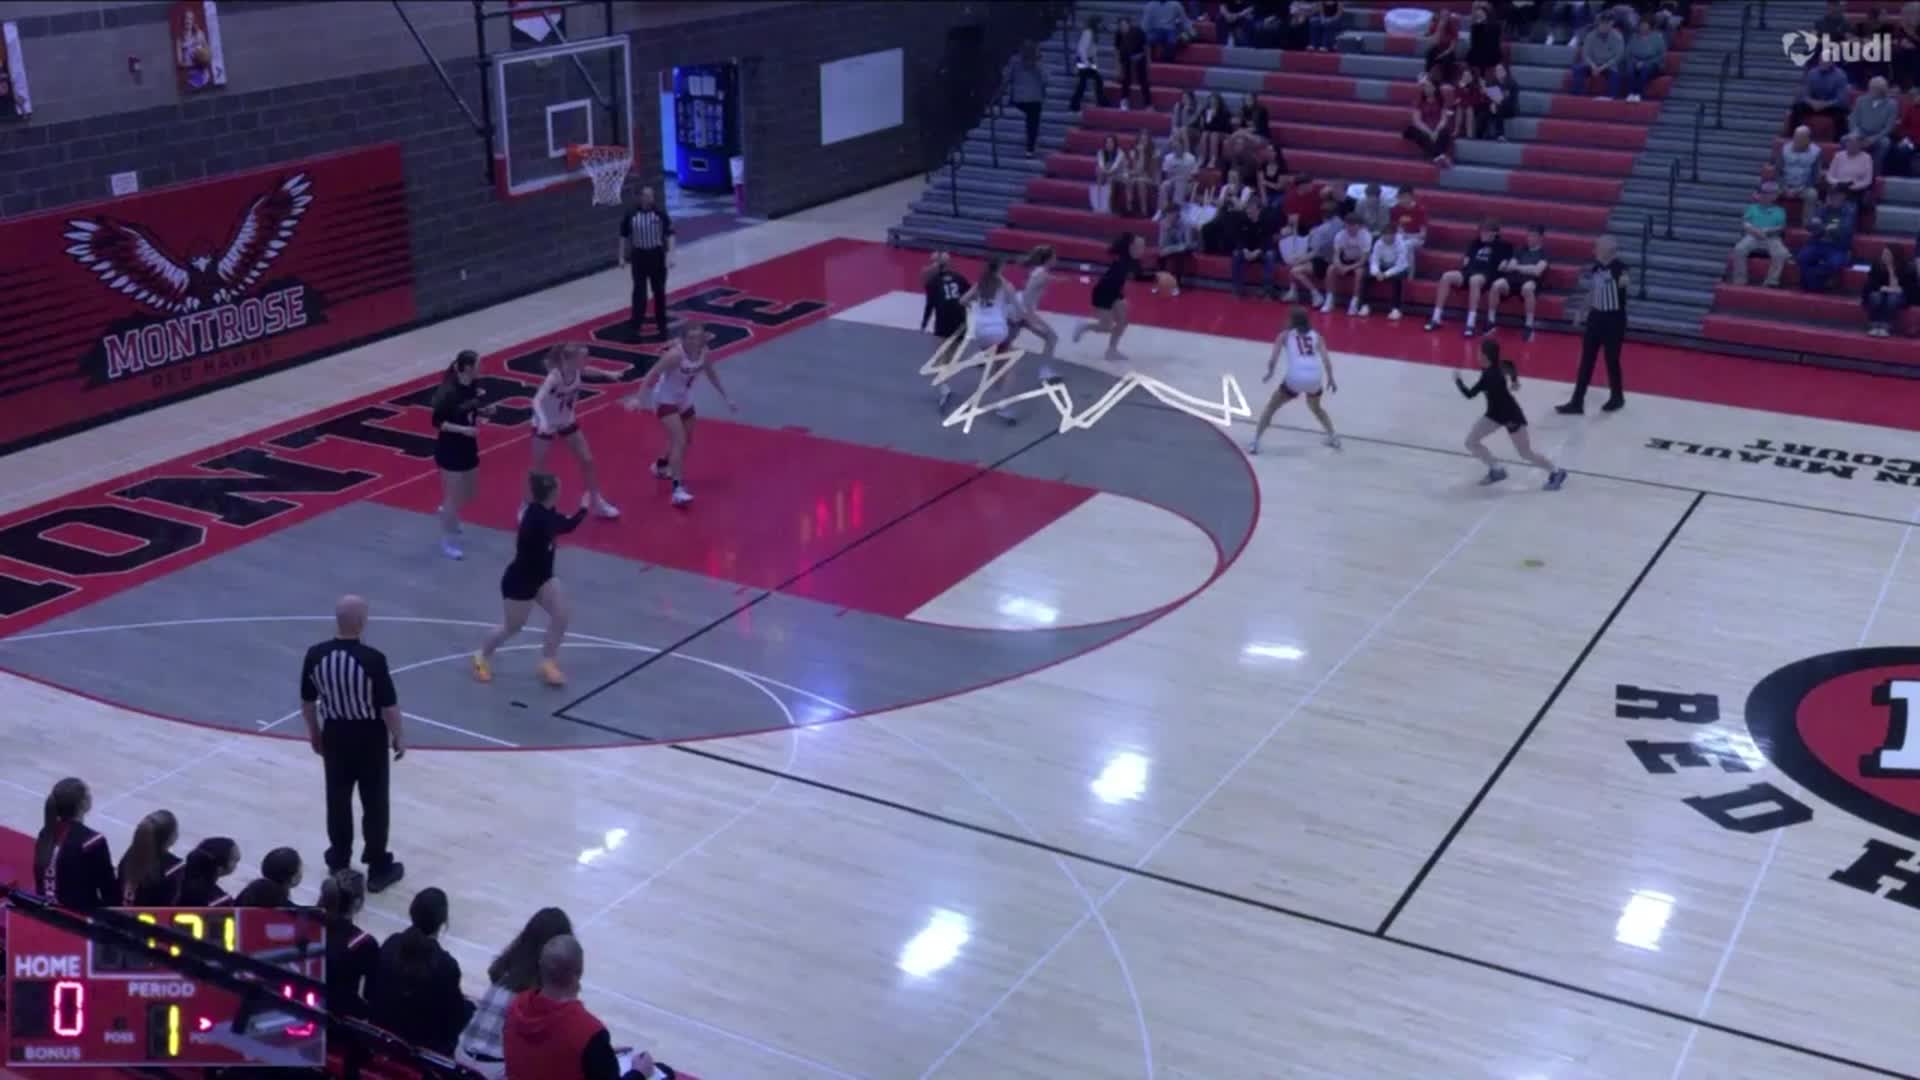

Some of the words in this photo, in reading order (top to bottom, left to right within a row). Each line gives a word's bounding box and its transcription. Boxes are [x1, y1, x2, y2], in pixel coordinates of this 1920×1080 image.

[943, 282, 960, 300] 12
[104, 285, 307, 378] MONTROSE
[1295, 335, 1315, 355] 15
[1645, 437, 1859, 480] MRAULE
[1615, 684, 1814, 834] RED
[14, 955, 81, 978] HOME
[127, 981, 196, 998] PERIOD
[53, 981, 84, 1037] 0
[23, 1046, 81, 1061] BONUS
